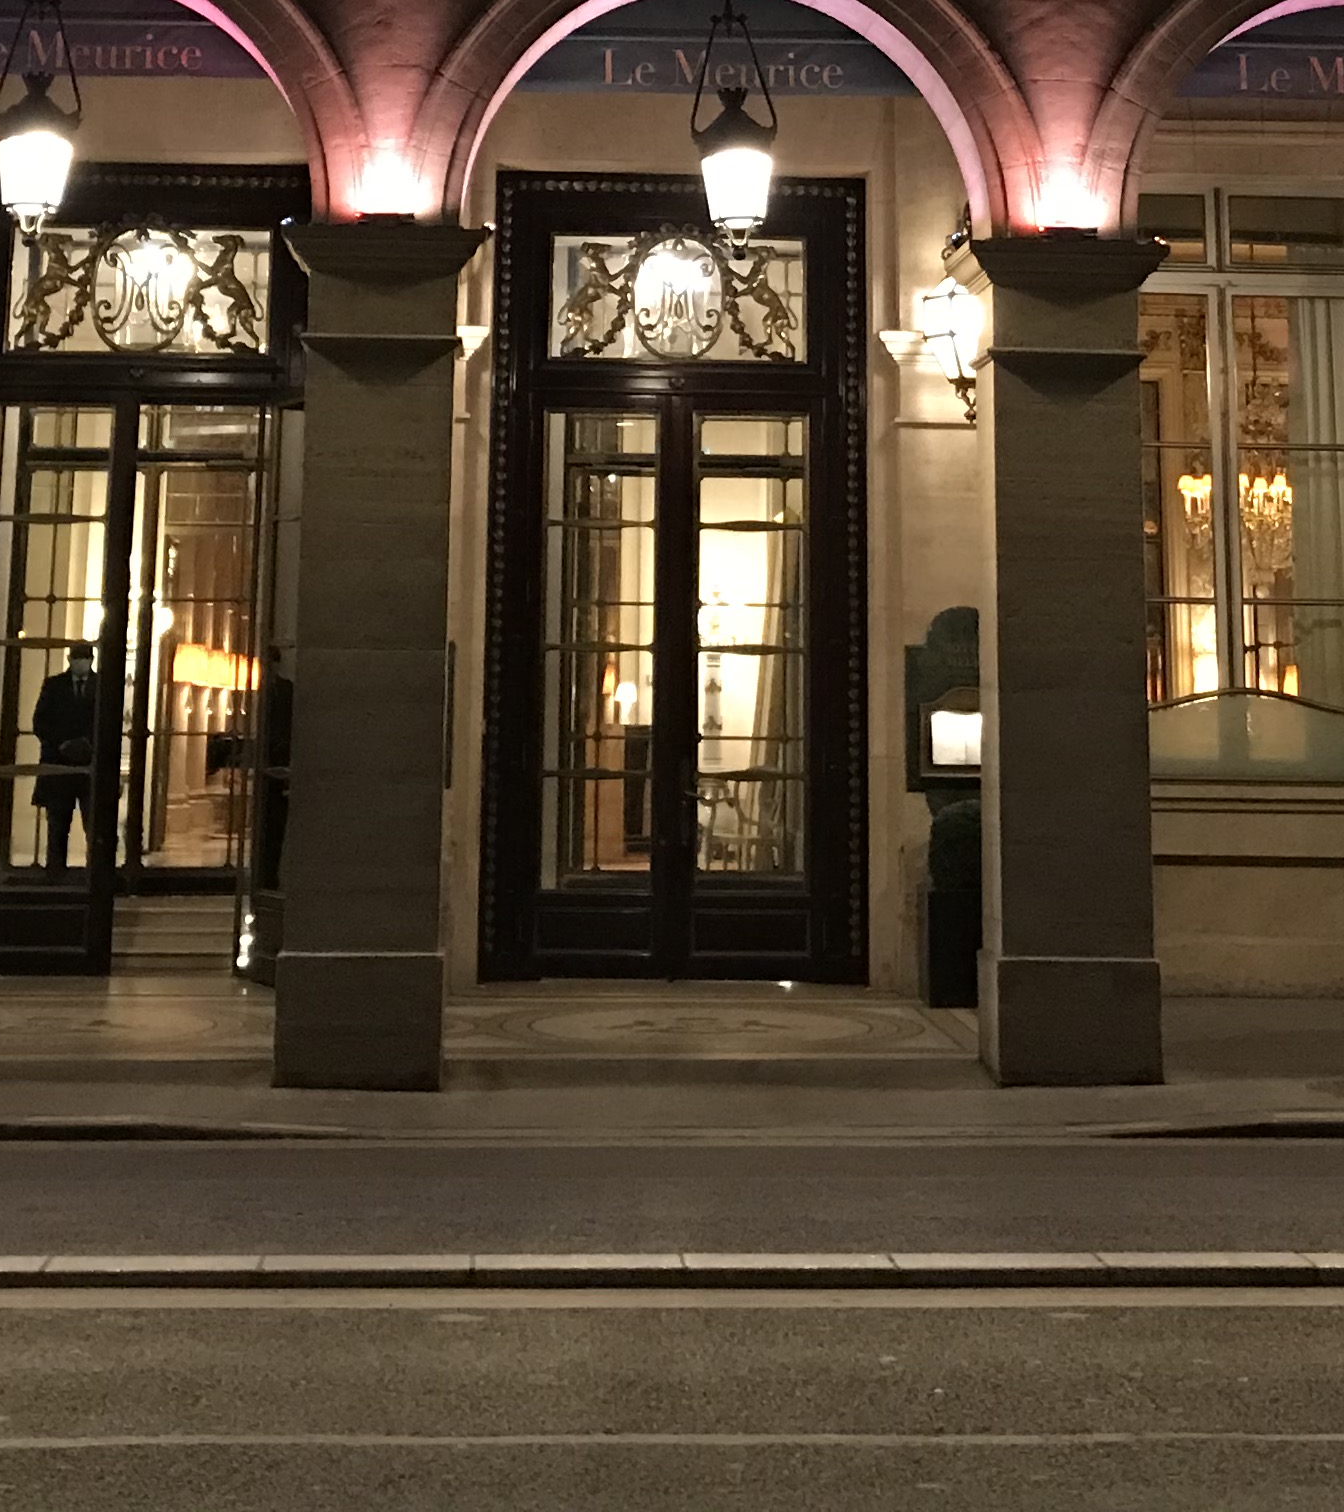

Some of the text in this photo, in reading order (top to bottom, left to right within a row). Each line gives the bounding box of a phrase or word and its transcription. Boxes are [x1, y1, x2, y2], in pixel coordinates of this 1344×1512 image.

[26, 28, 203, 71] Meurice
[602, 46, 845, 89] Le Meurice
[1235, 52, 1292, 93] Le
